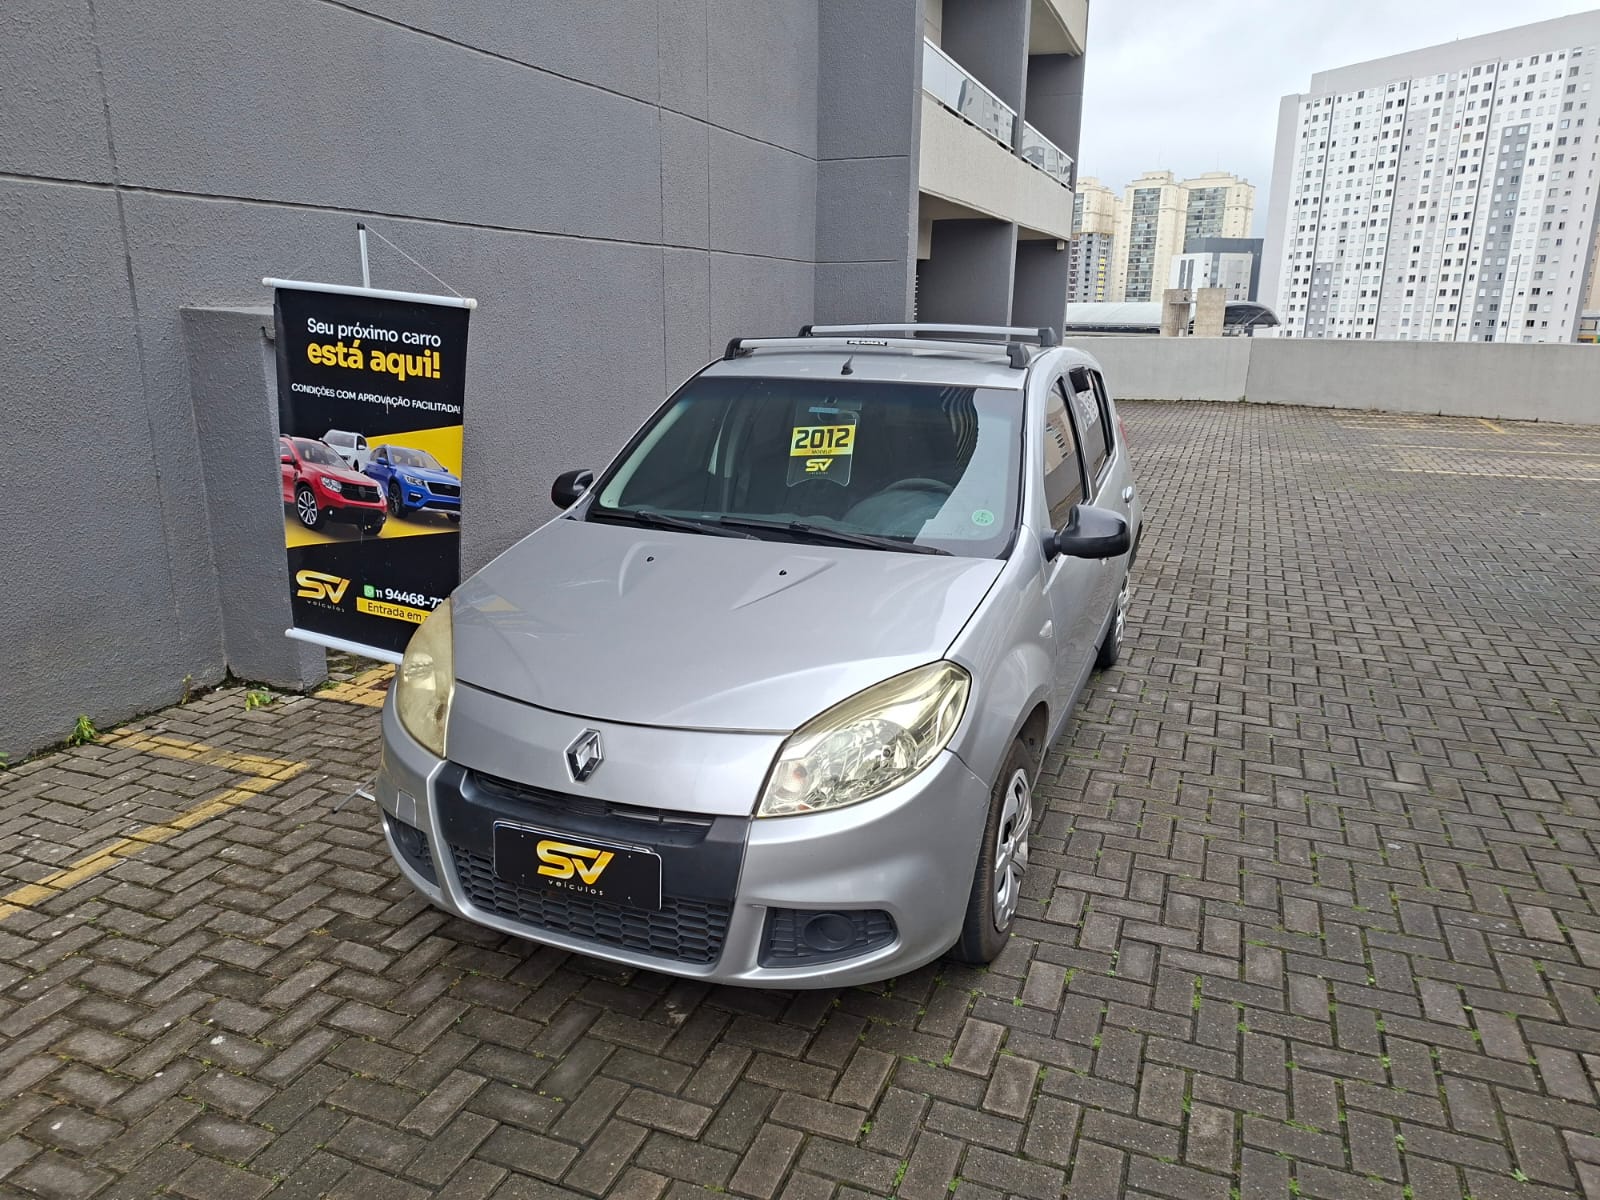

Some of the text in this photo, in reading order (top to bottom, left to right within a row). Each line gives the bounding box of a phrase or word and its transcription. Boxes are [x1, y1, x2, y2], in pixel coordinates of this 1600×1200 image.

[307, 317, 442, 347] Seu próximo carro
[307, 339, 441, 381] está aqui!
[291, 383, 461, 415] CONDIÇÕES COM APROVAÇÃO FACILITADA!
[795, 428, 850, 449] 2012
[805, 458, 833, 471] SV
[296, 570, 350, 603] SV
[367, 602, 422, 622] Entrada em
[537, 840, 615, 884] SV
